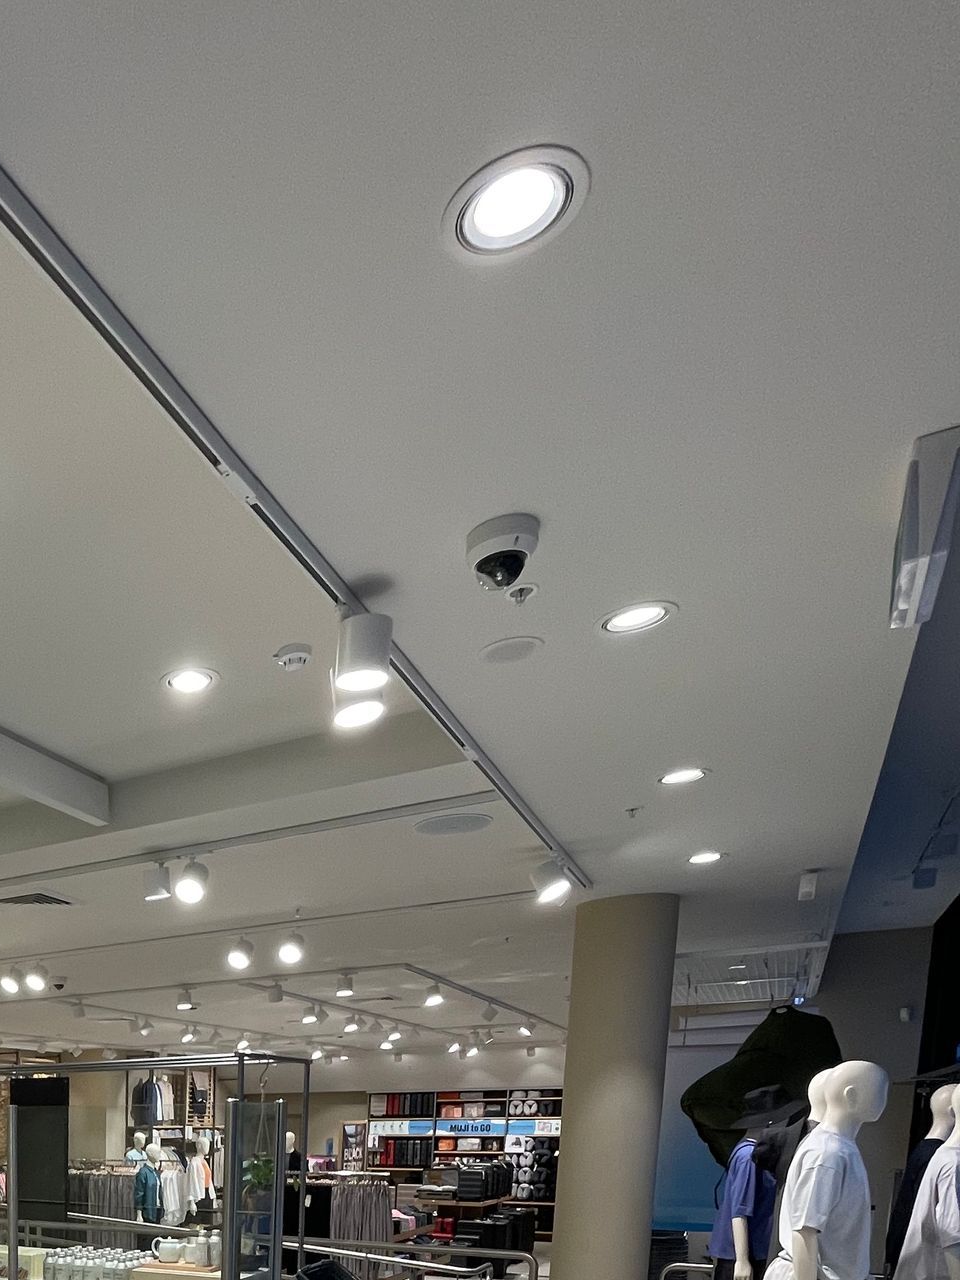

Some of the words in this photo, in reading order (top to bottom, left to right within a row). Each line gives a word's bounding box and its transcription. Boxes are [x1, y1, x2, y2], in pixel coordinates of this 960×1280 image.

[450, 1124, 469, 1132] MUJI
[471, 1124, 479, 1132] to
[480, 1124, 491, 1132] GO
[343, 1147, 362, 1160] BLACK
